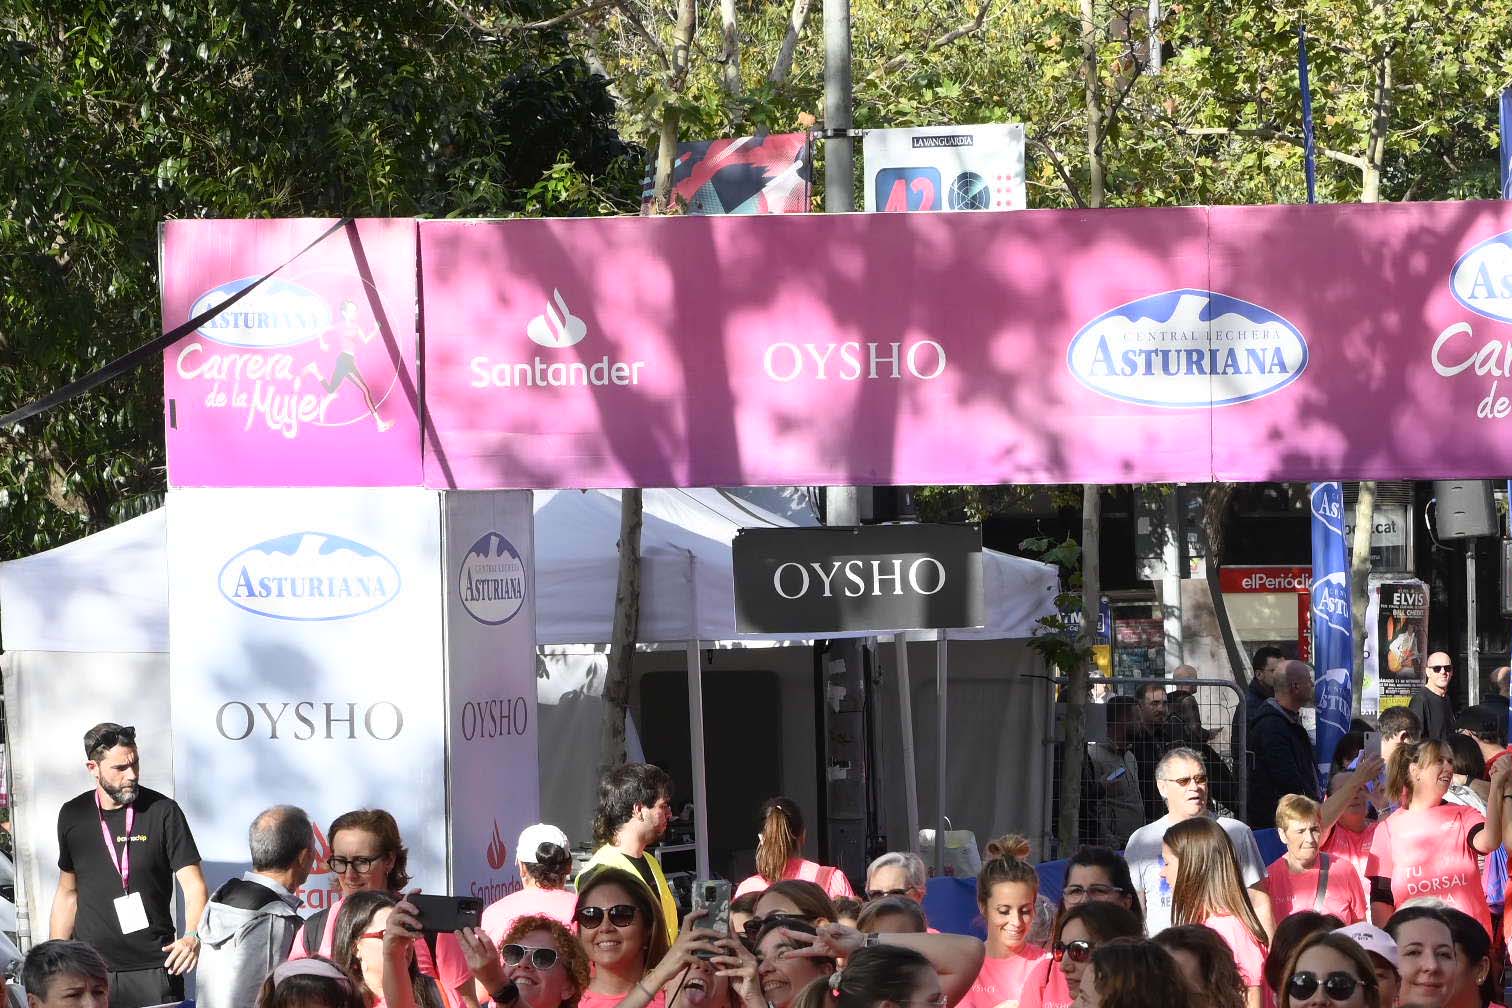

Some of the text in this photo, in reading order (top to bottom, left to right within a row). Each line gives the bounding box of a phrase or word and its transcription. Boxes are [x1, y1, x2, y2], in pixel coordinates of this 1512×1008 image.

[1122, 329, 1281, 342] CENTRAL LECHERA
[177, 343, 298, 382] Carrera
[469, 356, 645, 388] Santander
[763, 341, 947, 382] OYSHO
[1088, 334, 1290, 378] ASTURIANA
[205, 376, 339, 439] de la Mujer
[1477, 381, 1511, 419] de
[231, 564, 388, 599] ASTURIANA
[465, 568, 523, 602] ASTURIANA
[773, 557, 945, 601] OYSHO
[1393, 592, 1424, 605] ELVIS
[215, 701, 404, 741] OYSHO
[461, 697, 528, 742] OYSHO
[1408, 873, 1469, 895] DORSAL
